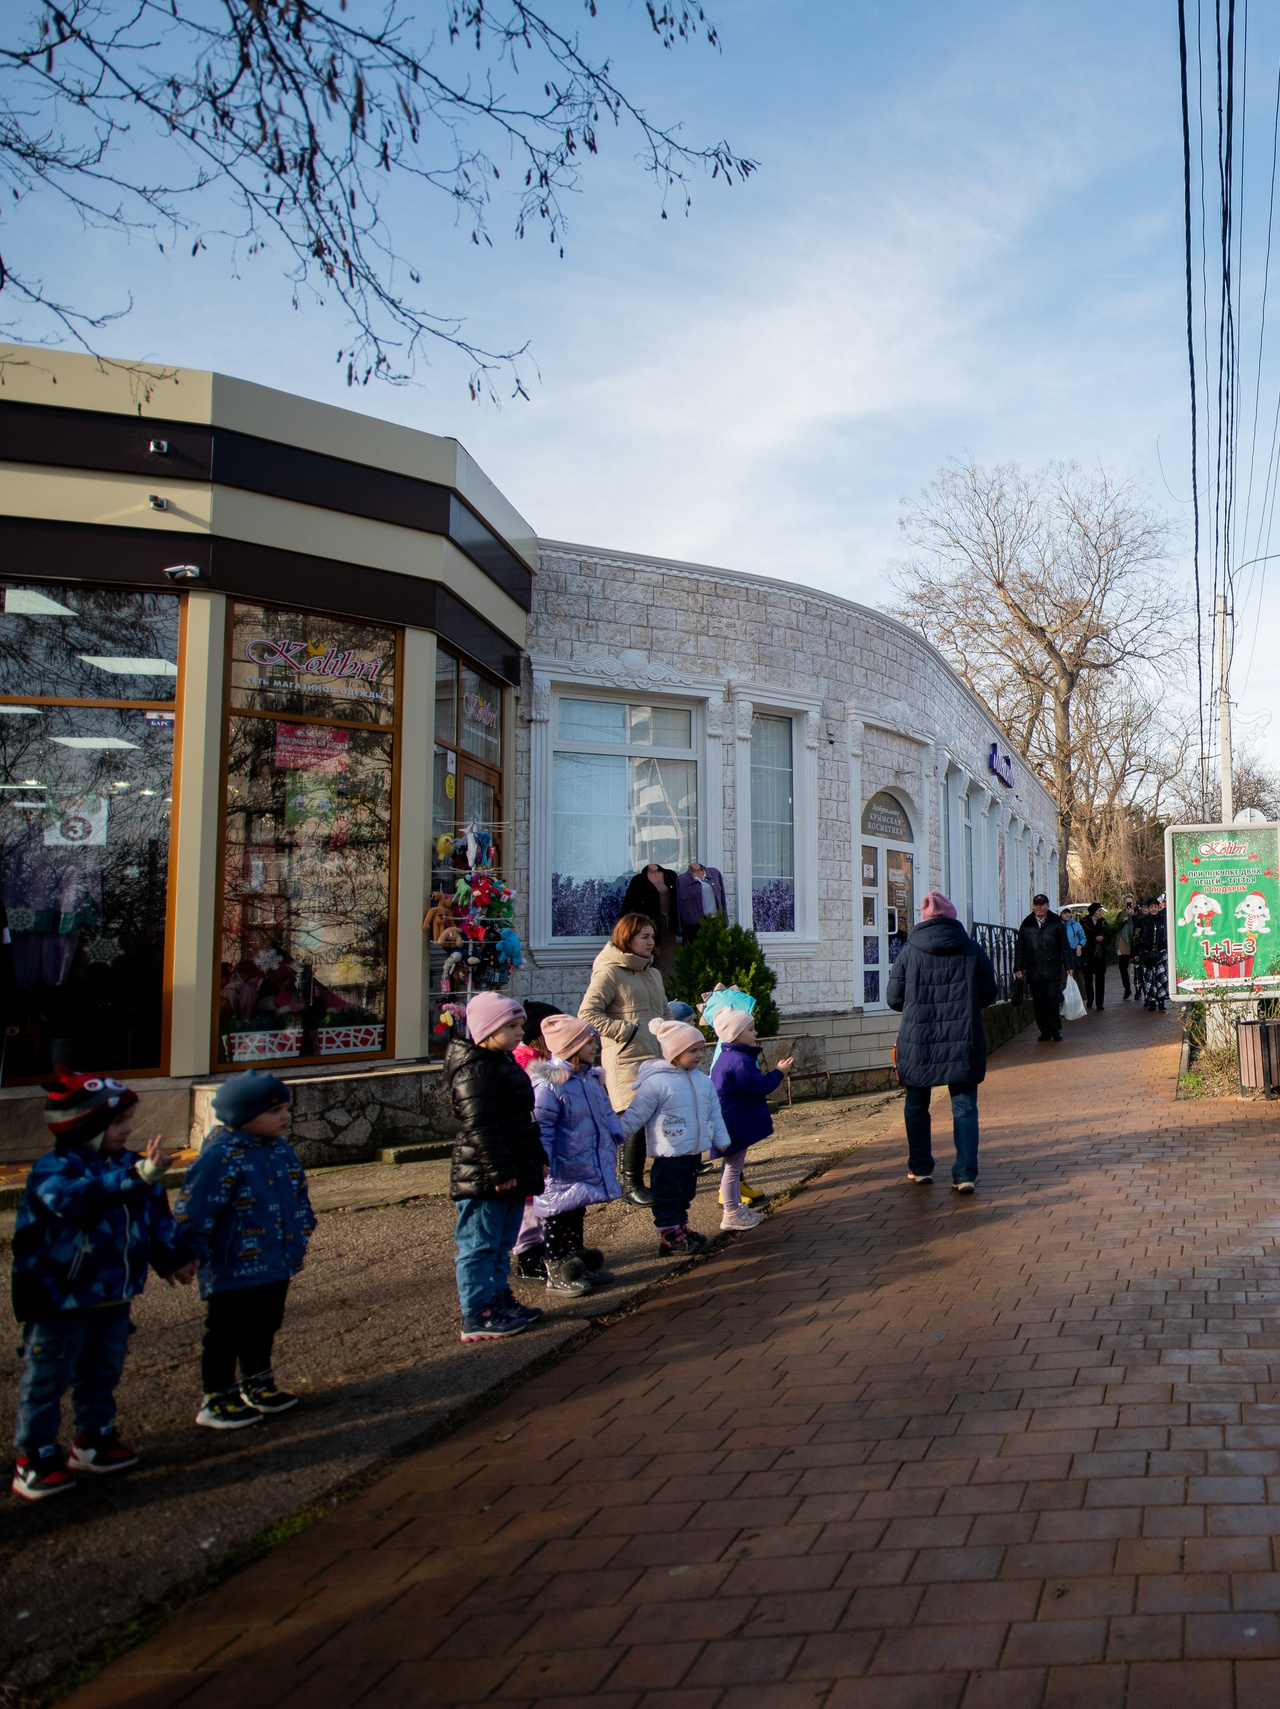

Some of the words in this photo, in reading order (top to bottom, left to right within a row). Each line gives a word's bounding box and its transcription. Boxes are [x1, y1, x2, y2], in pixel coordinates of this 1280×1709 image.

[245, 639, 383, 681] Kolibri
[244, 677, 270, 686] СЕТЬ
[273, 680, 336, 693] МАГАЗИНОВ
[339, 687, 384, 699] ОДЕЖДЫ
[869, 813, 901, 826] КРЫМСКАЯ
[867, 821, 903, 835] КОСМЕТИКА
[1199, 840, 1248, 856] Kolibri
[1205, 869, 1239, 877] ПОКУПКЕ
[1241, 868, 1262, 876] ДВУХ
[1195, 877, 1221, 886] ВЕЩЕЙ
[1228, 876, 1256, 884] ТРЕТЬЯ
[1211, 885, 1247, 894] ПОДАРОК
[1201, 938, 1256, 956] 1+1=3
[233, 1264, 269, 1278] LASSIE
